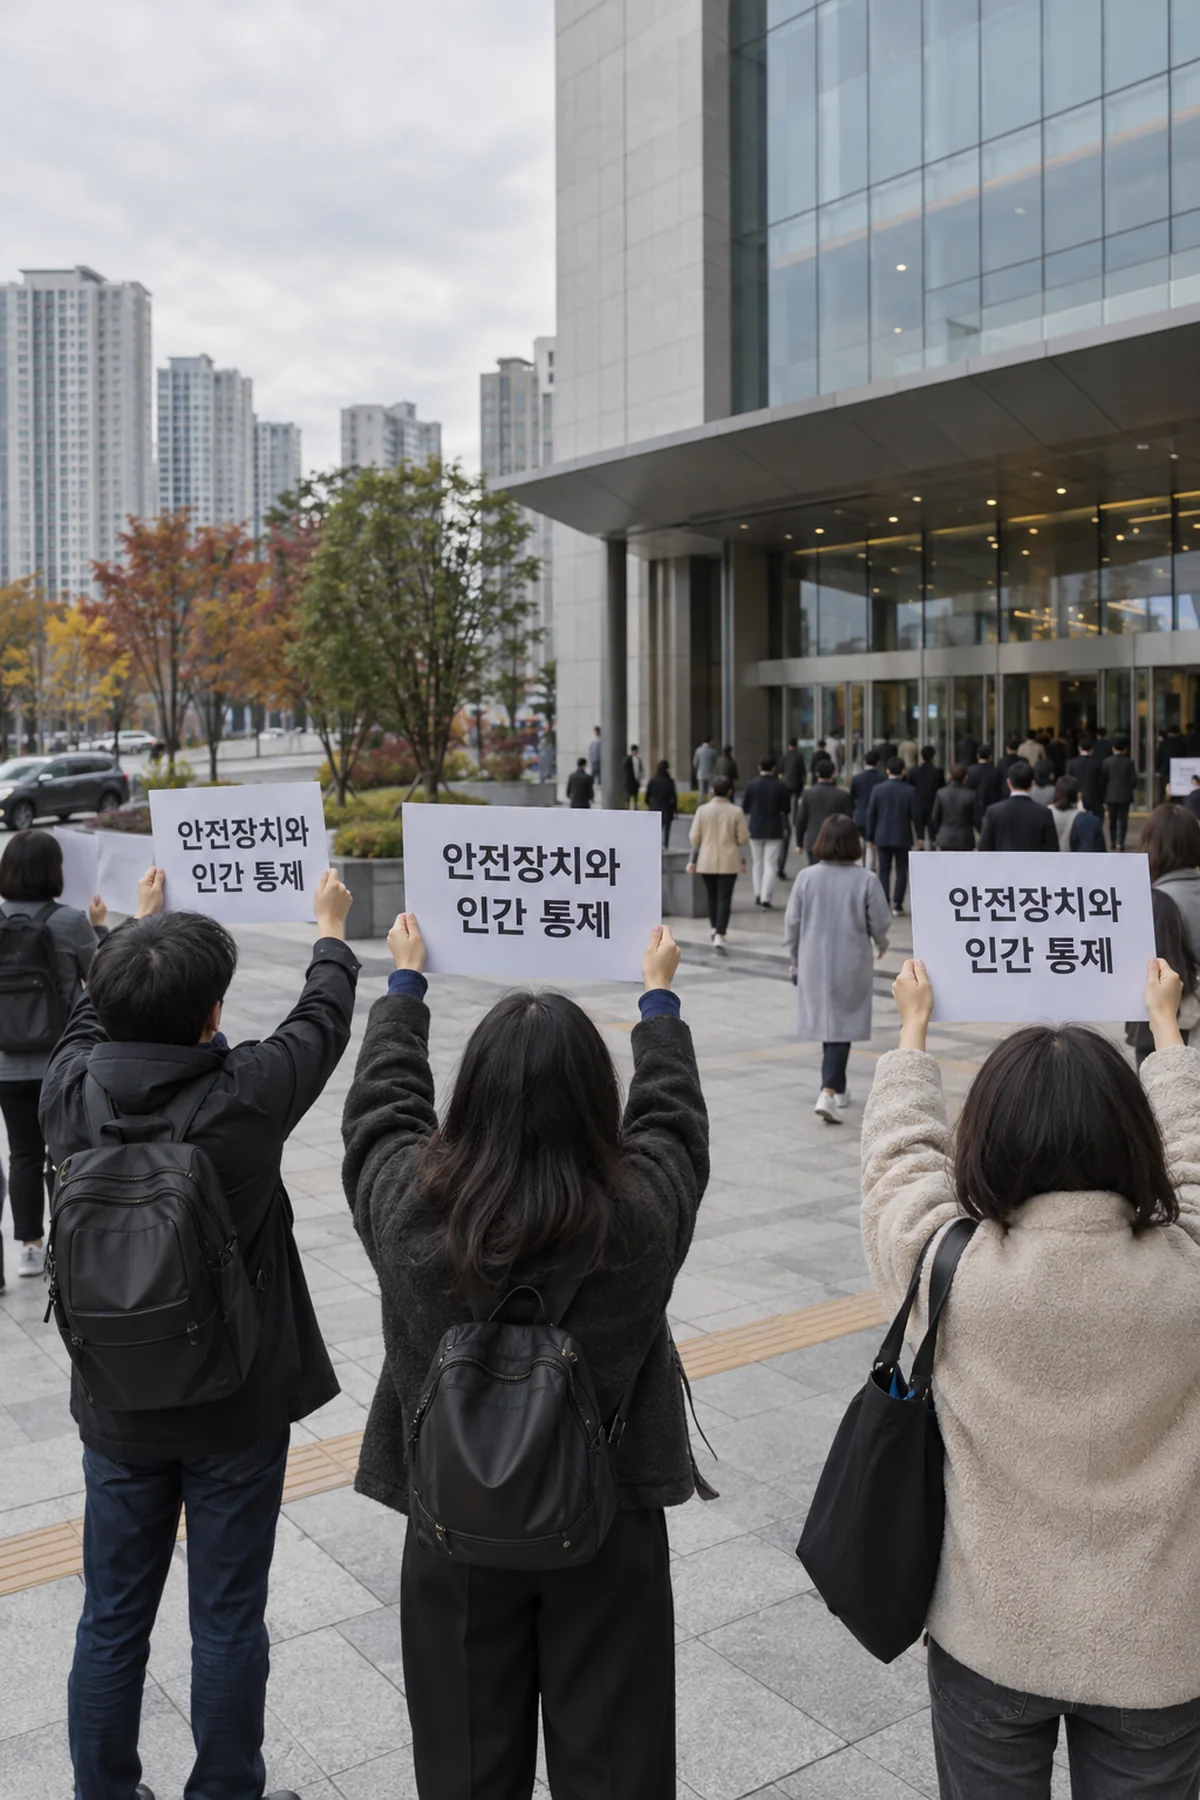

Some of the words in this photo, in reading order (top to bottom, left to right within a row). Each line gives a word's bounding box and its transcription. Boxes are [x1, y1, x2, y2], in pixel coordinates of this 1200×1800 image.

[178, 816, 309, 850] 안전장치와
[192, 862, 244, 893] 인간
[254, 860, 304, 892] 통제
[443, 843, 620, 886] 안전장치와
[457, 896, 527, 935] 인간
[540, 900, 610, 939] 통제
[949, 887, 1122, 922] 안전장치와
[966, 937, 1034, 973] 인간
[1046, 937, 1113, 974] 통제
